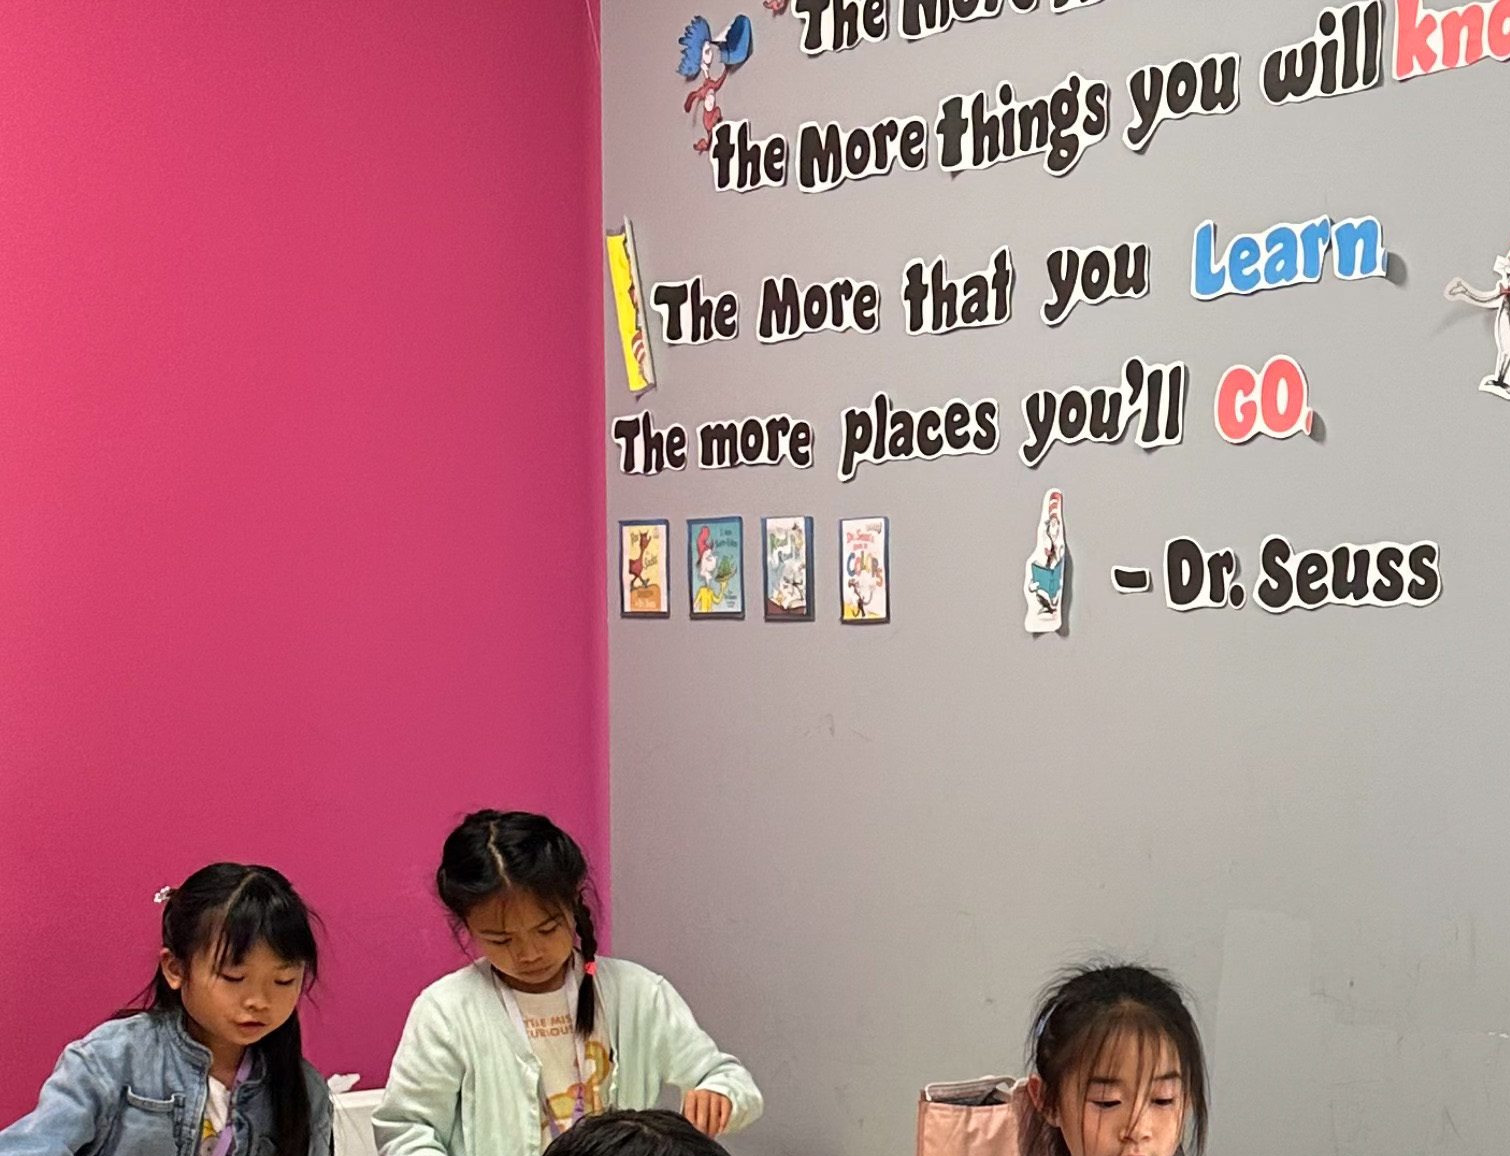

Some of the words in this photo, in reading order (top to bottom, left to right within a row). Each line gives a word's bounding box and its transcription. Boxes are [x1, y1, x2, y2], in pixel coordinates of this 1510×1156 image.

[800, 0, 884, 50] The
[714, 124, 783, 188] the
[800, 120, 924, 187] More
[937, 76, 1105, 171] things
[1128, 57, 1235, 148] you
[1264, 2, 1382, 102] will
[655, 279, 736, 342] The
[760, 278, 876, 337] More
[904, 250, 1009, 334] that
[1045, 244, 1145, 321] you
[615, 412, 685, 473] The
[701, 417, 810, 467] more
[842, 394, 995, 475] places
[1024, 360, 1181, 466] you'll
[1168, 539, 1243, 606] Dr.
[1259, 539, 1437, 606] Seuss
